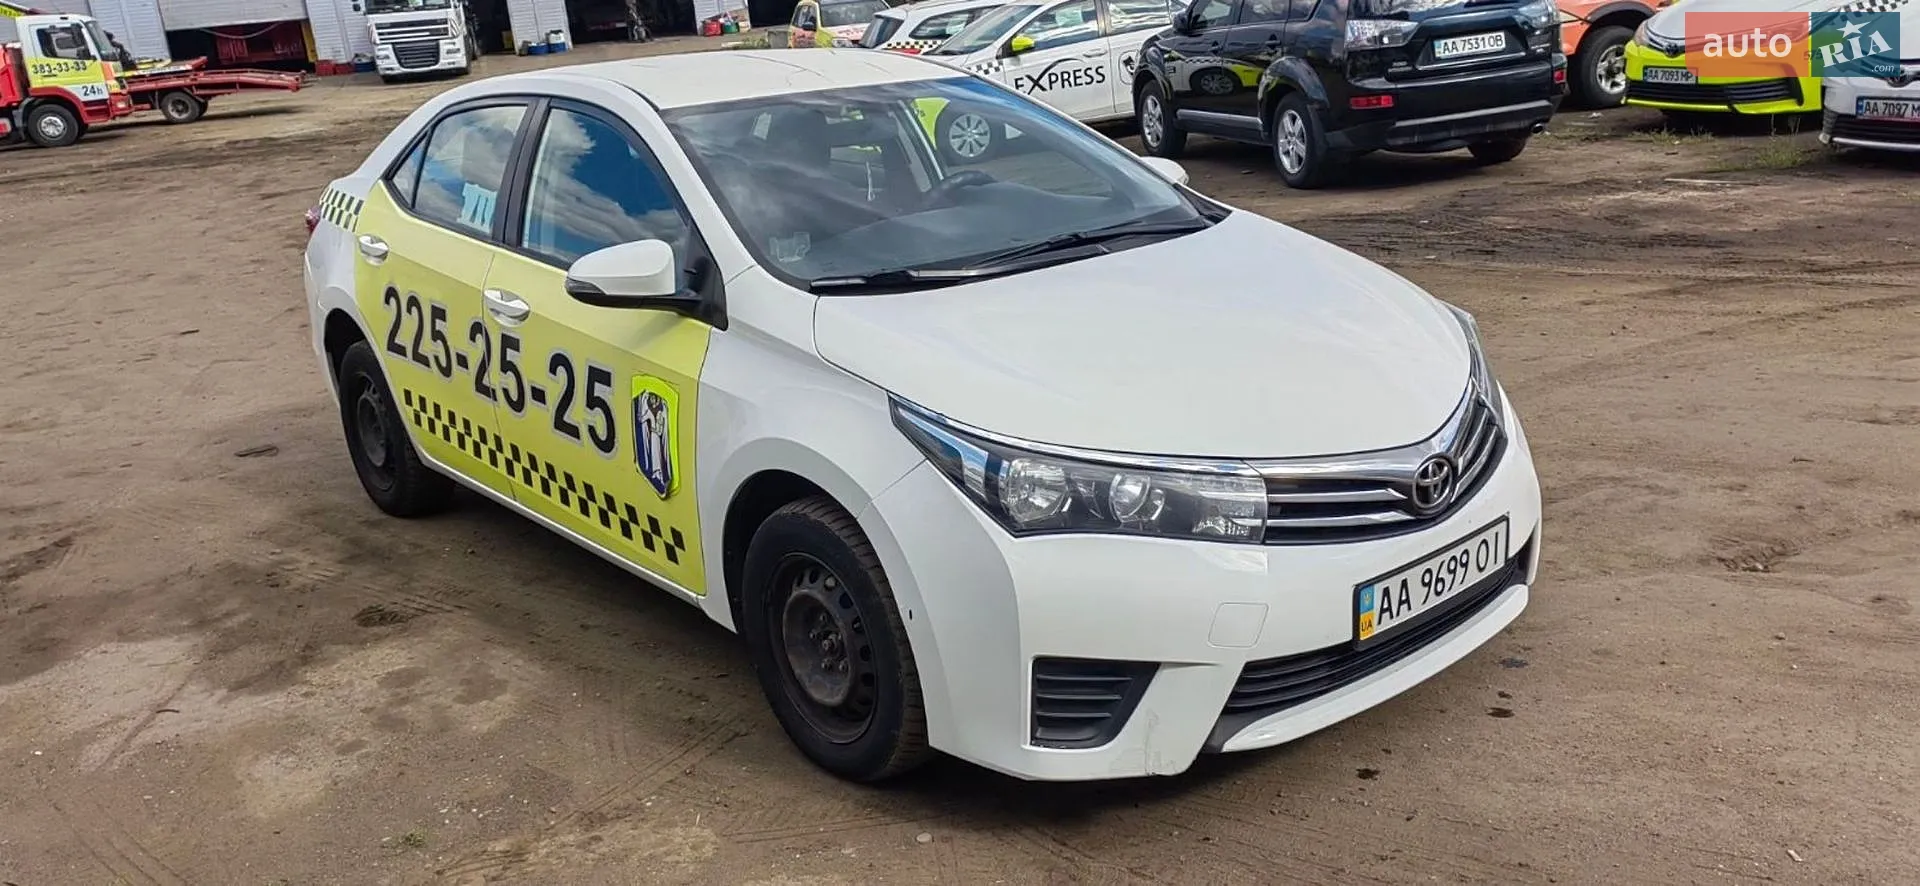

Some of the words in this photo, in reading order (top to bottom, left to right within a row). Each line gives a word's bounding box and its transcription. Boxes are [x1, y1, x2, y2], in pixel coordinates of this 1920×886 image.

[1442, 41, 1459, 55] AA
[31, 60, 88, 74] 383-33-33
[1014, 58, 1106, 95] EXPRESS
[82, 85, 103, 97] 24h
[1864, 101, 1879, 115] AA
[383, 285, 617, 455] 225-25-25
[1376, 577, 1412, 626] AA
[1420, 548, 1470, 605] 9699
[1475, 531, 1499, 573] OI
[1361, 619, 1373, 632] UA
